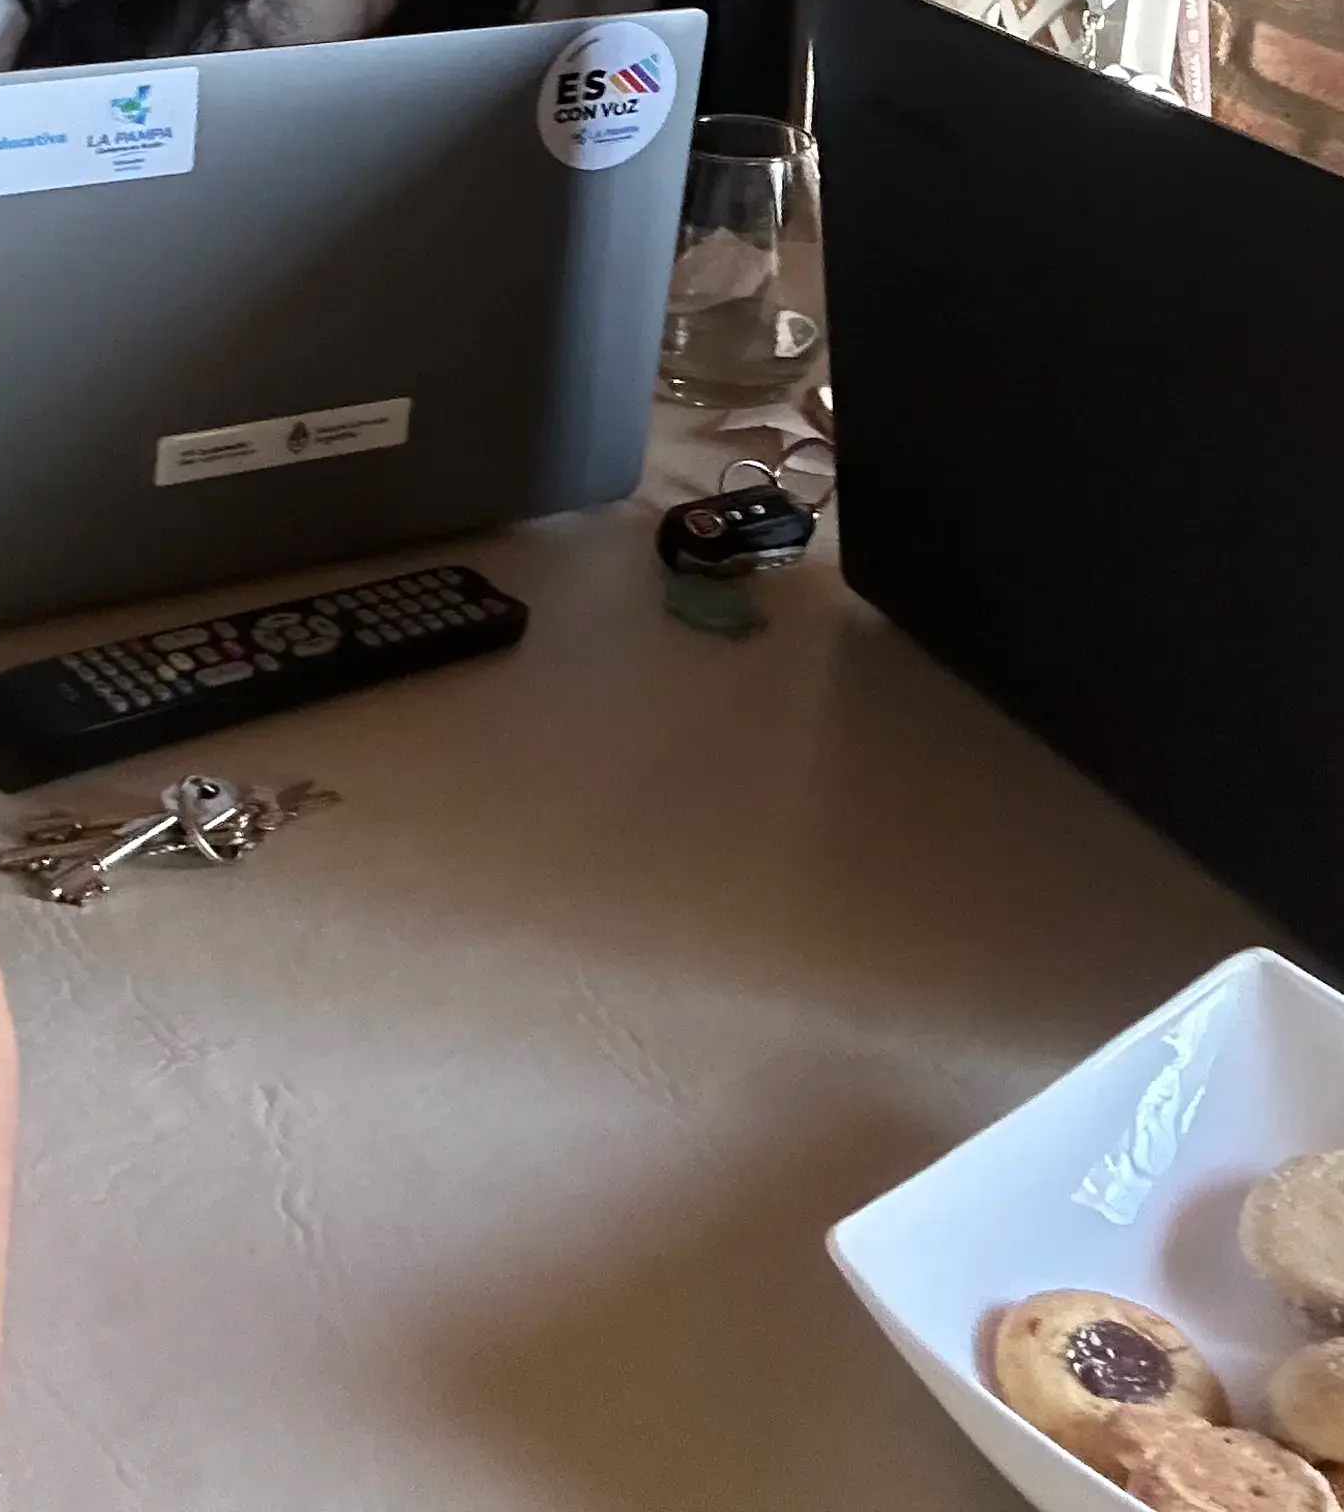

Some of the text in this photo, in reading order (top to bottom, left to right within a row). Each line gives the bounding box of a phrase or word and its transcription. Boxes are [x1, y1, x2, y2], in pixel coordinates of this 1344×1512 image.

[557, 69, 608, 105] ES
[554, 104, 597, 123] CON
[87, 134, 110, 148] LA
